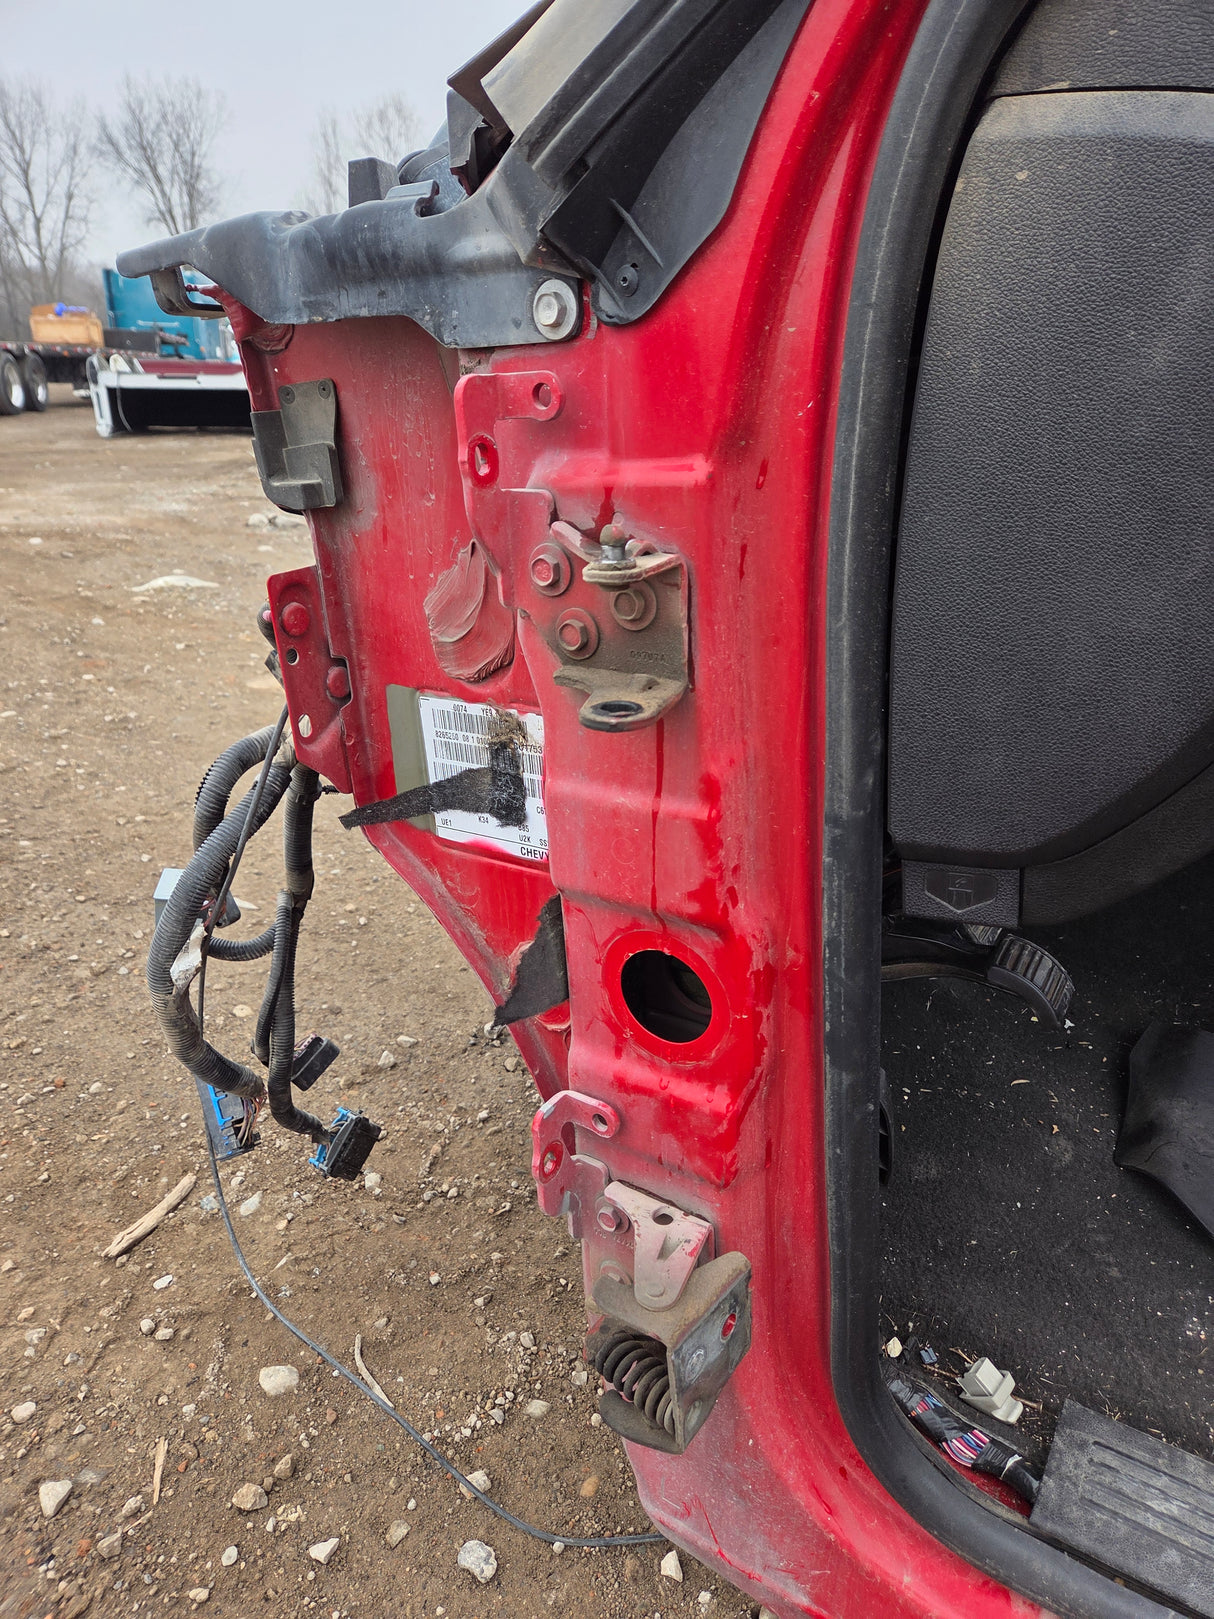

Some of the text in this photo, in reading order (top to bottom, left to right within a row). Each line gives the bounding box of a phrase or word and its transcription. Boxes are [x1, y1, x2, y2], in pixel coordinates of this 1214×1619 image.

[478, 815, 489, 824] K34
[440, 817, 452, 827] UE1
[519, 834, 531, 843] U2K
